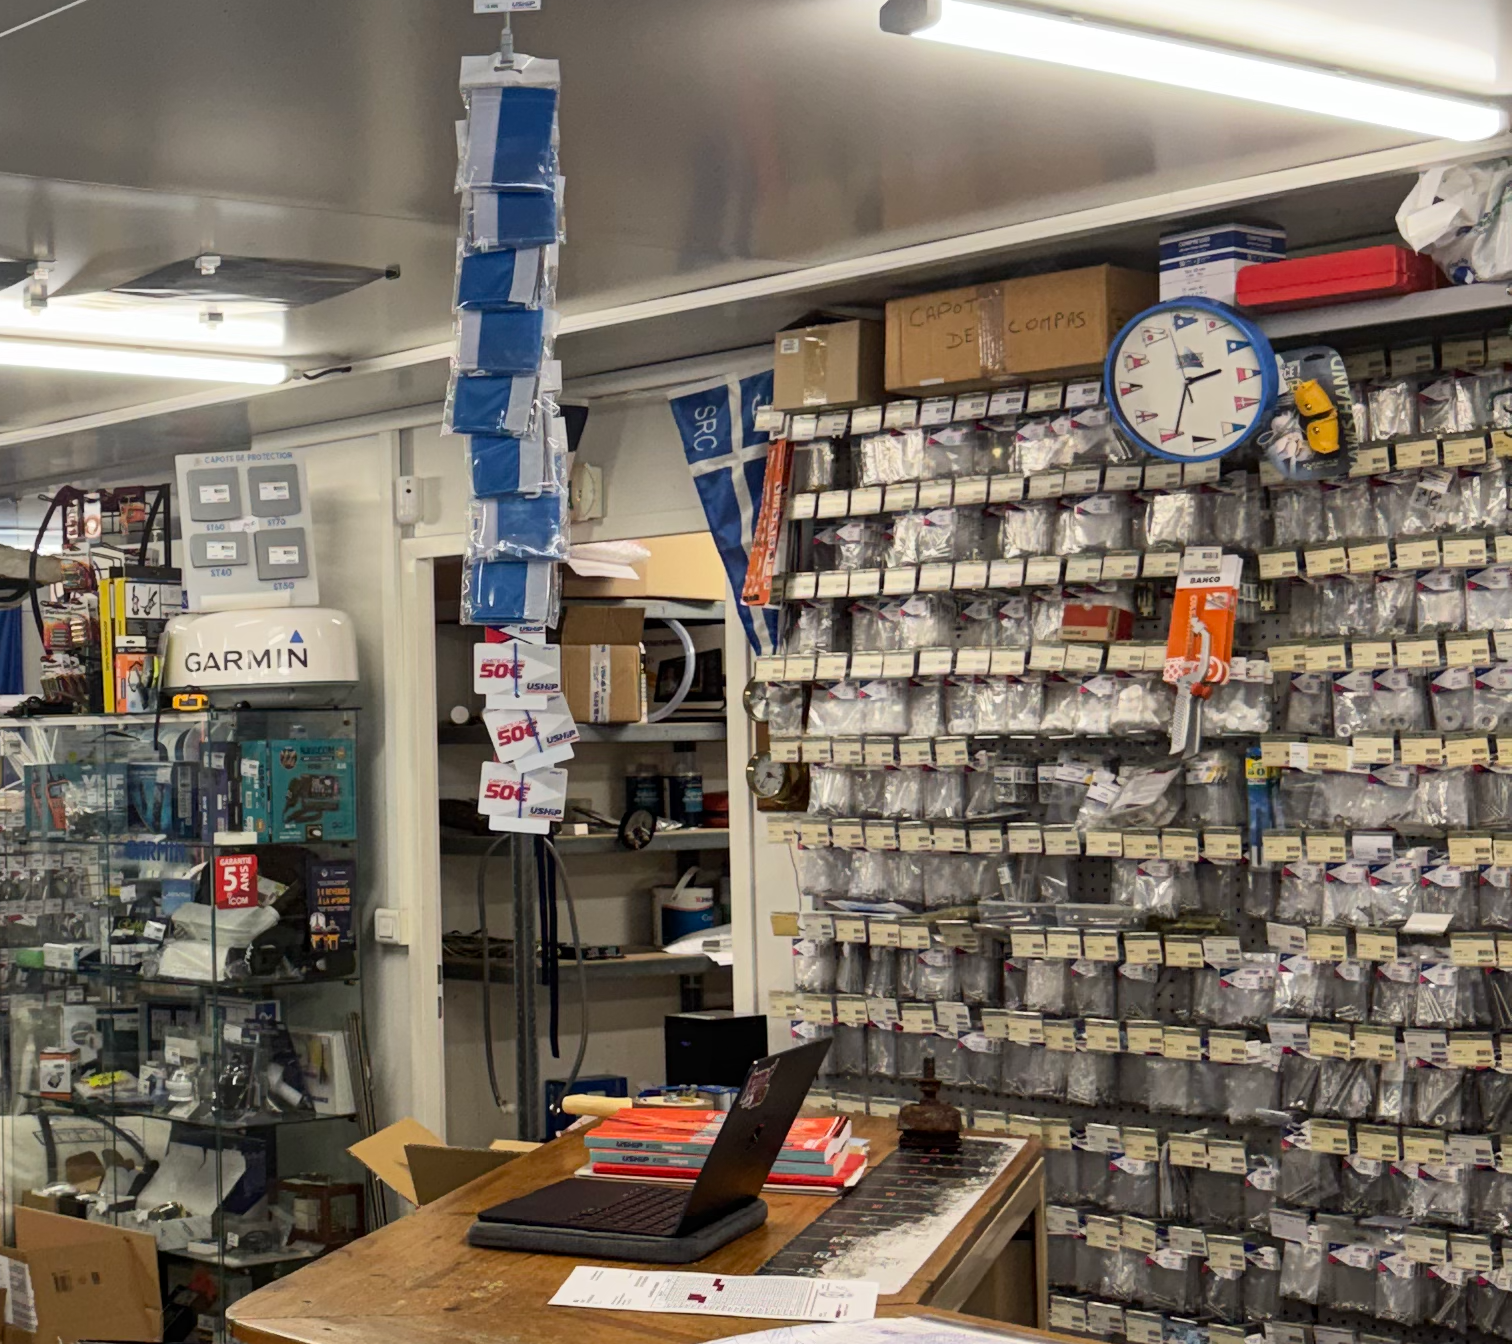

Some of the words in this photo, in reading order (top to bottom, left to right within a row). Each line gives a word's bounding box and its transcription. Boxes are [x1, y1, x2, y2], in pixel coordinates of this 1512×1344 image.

[909, 296, 978, 329] CAPOT
[1007, 310, 1086, 334] COMPAS
[946, 325, 975, 349] DE
[694, 405, 718, 451] SRC
[185, 648, 308, 673] GARMIN
[479, 663, 525, 679] 50€
[497, 721, 539, 746] 50€
[81, 773, 124, 788] VHF
[484, 783, 531, 801] 50€
[220, 857, 253, 866] GARANTIE
[223, 866, 238, 892] 5
[240, 865, 250, 892] ANS
